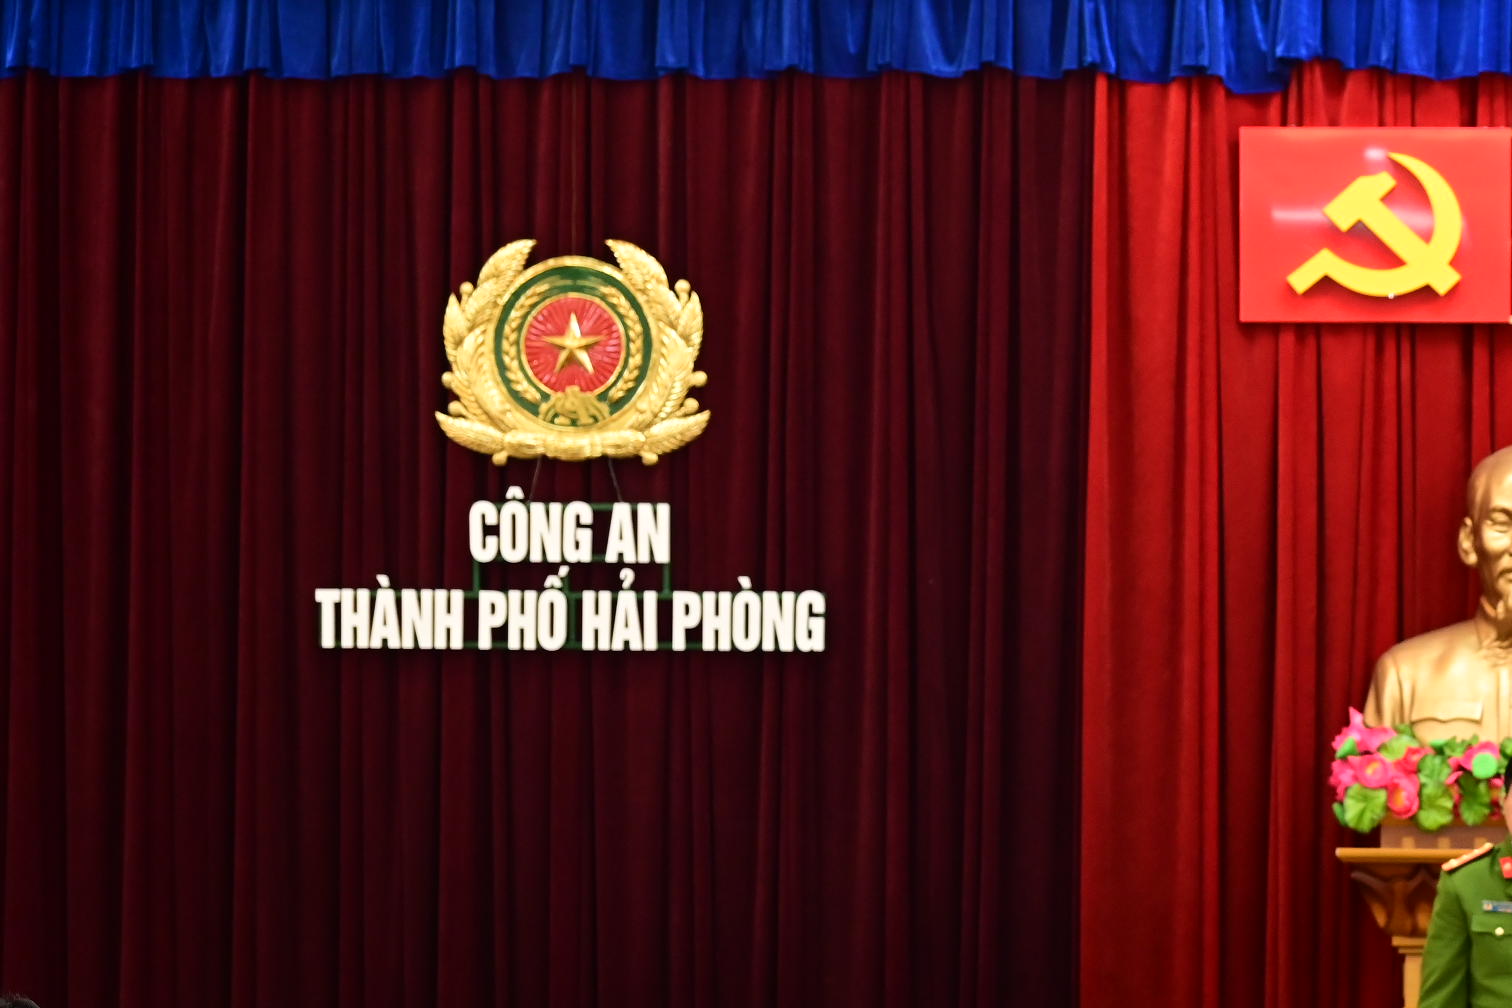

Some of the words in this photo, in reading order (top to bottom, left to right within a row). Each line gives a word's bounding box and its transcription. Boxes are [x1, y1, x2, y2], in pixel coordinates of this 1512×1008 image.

[469, 486, 594, 564] CÔNG
[605, 501, 671, 564] AN
[315, 574, 464, 649] THÀNH
[478, 565, 570, 651] PHỐ
[581, 569, 659, 651] HẢI
[671, 576, 826, 652] PHÒNG
